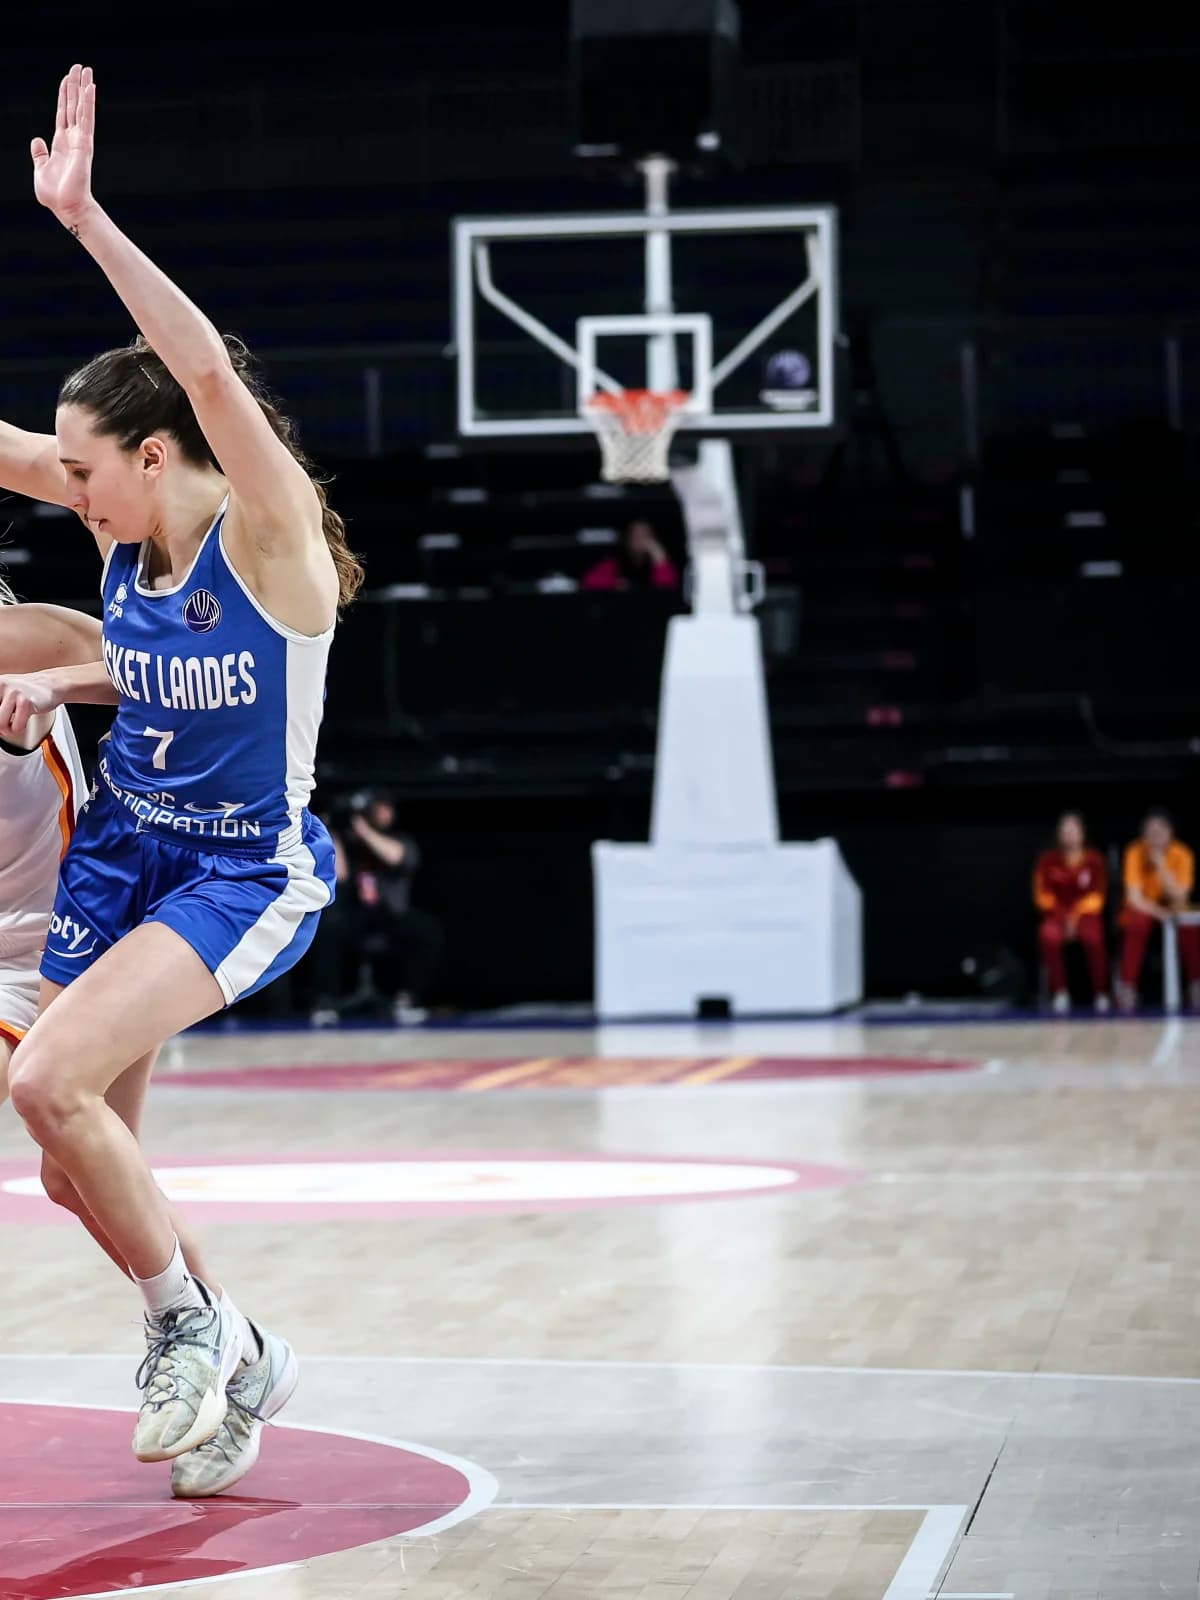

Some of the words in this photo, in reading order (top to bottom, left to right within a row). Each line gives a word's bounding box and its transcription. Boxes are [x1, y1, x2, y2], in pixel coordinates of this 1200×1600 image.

[102, 634, 150, 703] SKET
[157, 651, 257, 710] LANDES
[143, 726, 174, 771] 7
[99, 757, 261, 838] PARTICIPATION
[49, 911, 91, 951] oty
